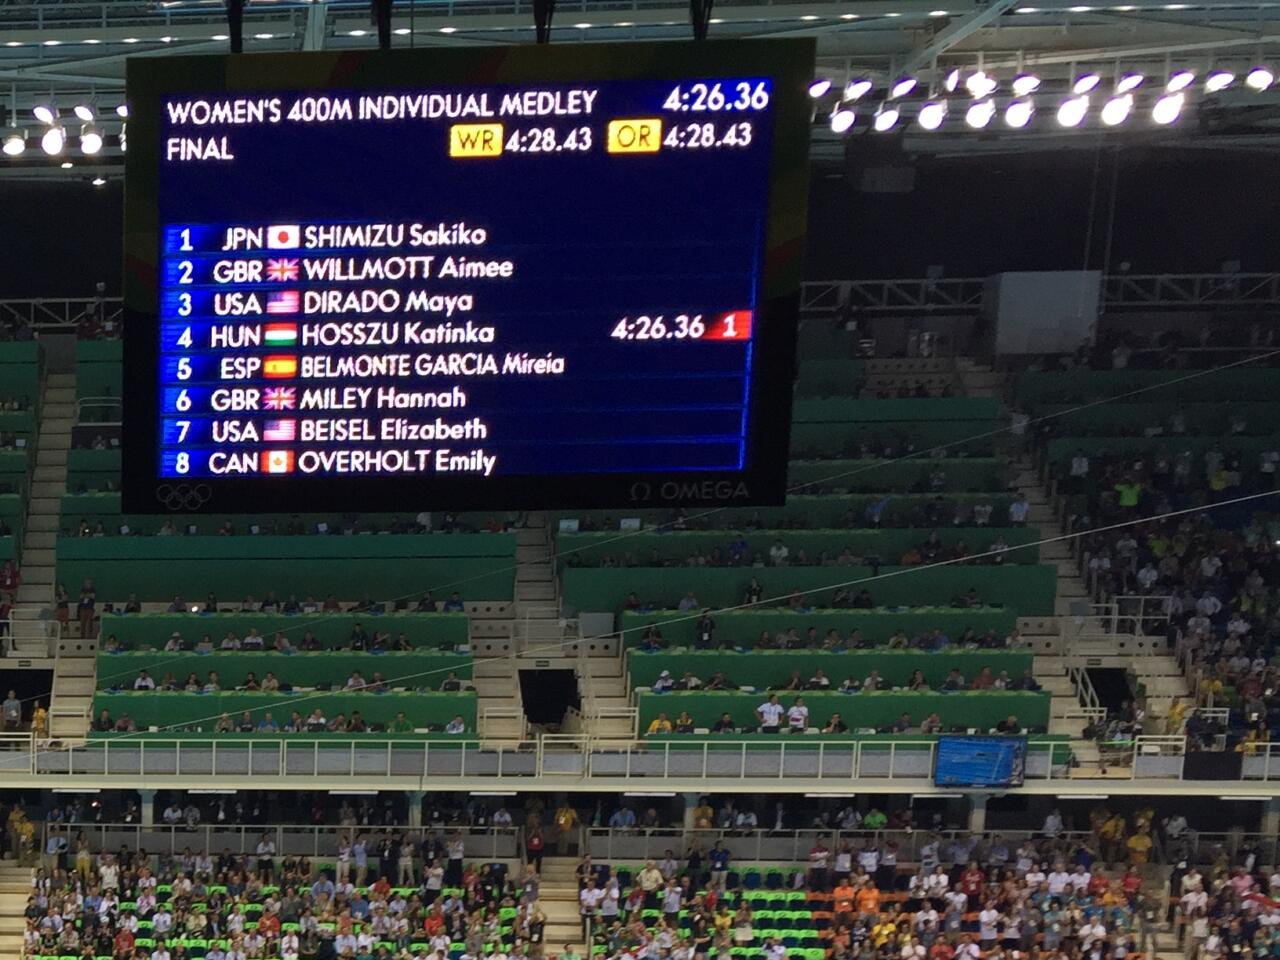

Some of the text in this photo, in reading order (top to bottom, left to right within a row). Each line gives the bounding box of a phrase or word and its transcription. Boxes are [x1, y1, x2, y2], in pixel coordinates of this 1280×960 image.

[167, 90, 597, 124] WOMEN'S 400M INDIVIDUAL MEDLEY
[663, 82, 768, 111] 4:26.36
[457, 129, 496, 153] WR
[505, 127, 592, 152] 4:28.43
[615, 124, 653, 149] OR
[663, 122, 751, 147] 4:28.43
[168, 137, 234, 160] FINAL
[180, 222, 486, 251] 1 JPN SHIMIZU Sakiko
[178, 256, 513, 283] 2 GBR WILLMOTT Aimee
[178, 289, 472, 317] 3 USA DIRADO Maya
[177, 321, 494, 348] 4 HUN HOSSZU Katinka
[611, 315, 737, 339] 4:26.36 1
[177, 352, 564, 379] 5 ESP BELMONTE GARCIA Mireia
[176, 386, 465, 411] 6 GBR MILEY Hannah
[176, 418, 486, 442] 7 USA BEISEL Elizabeth
[176, 449, 496, 476] 8 CAN OVERHOLT Emily
[661, 480, 750, 500] OMEGA
